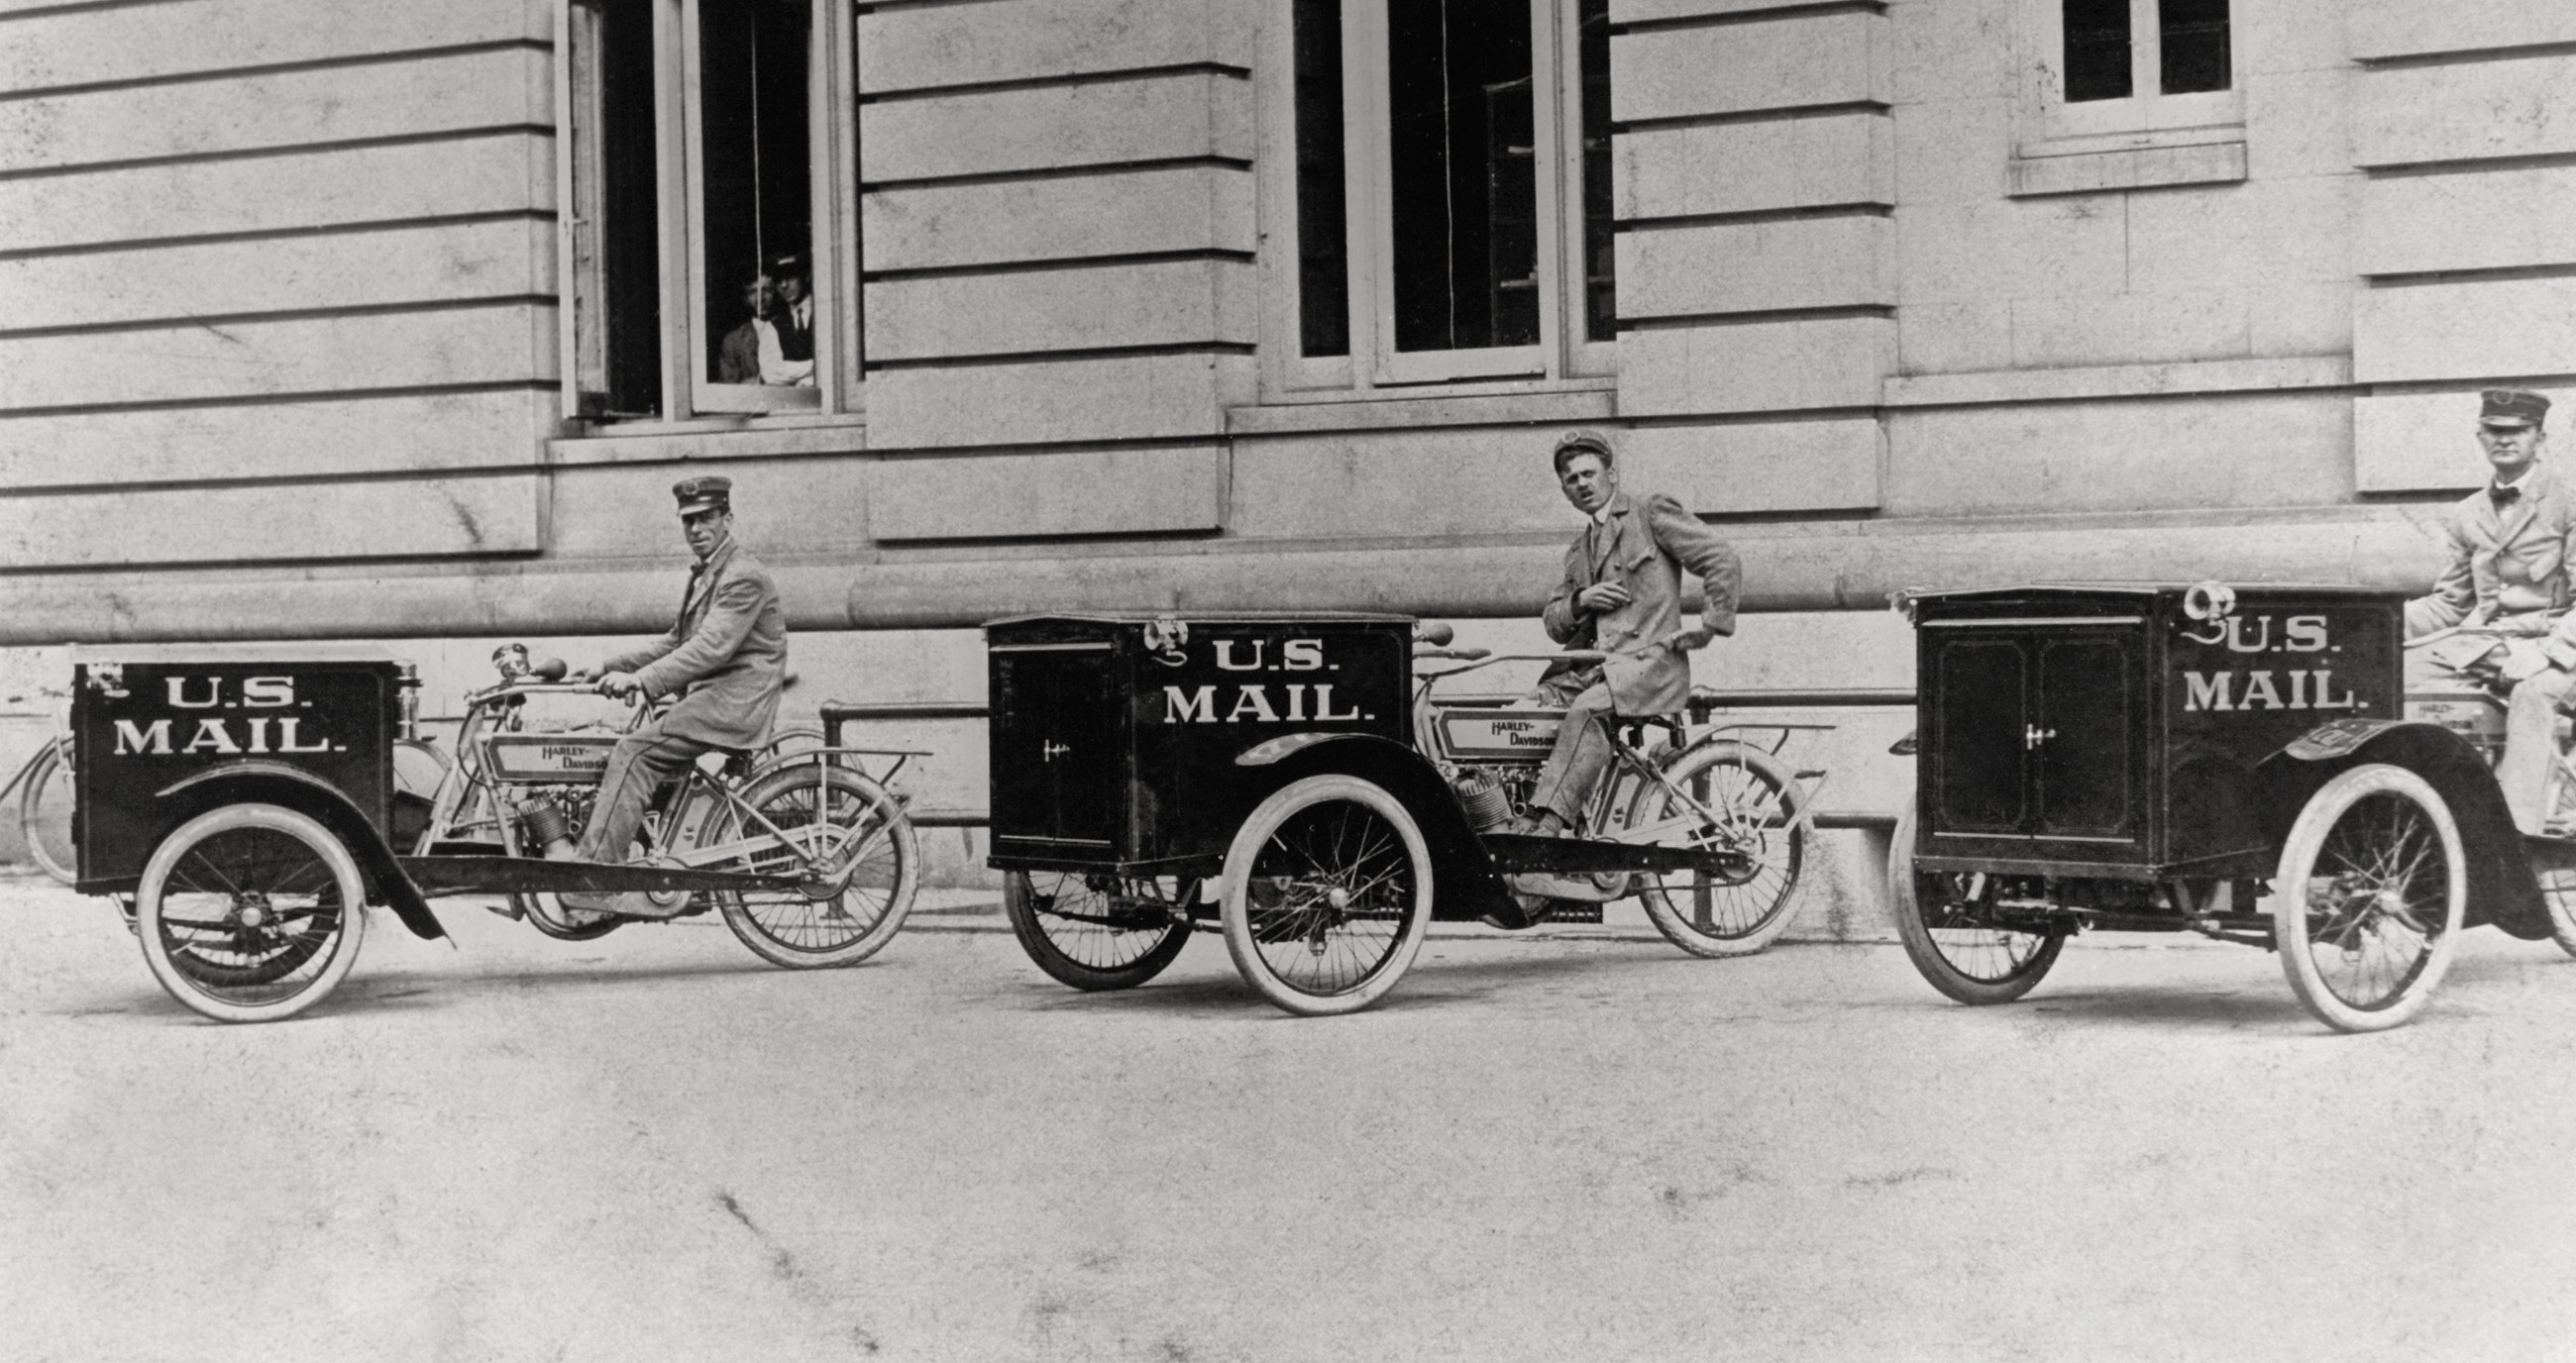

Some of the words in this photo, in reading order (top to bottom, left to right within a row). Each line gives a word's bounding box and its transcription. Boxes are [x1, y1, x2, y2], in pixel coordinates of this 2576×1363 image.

[2224, 615, 2342, 653] U.S.
[1212, 638, 1340, 672] U.S.
[164, 677, 313, 708] U.S.
[1163, 683, 1375, 724] MAIL.
[2183, 670, 2370, 712] MAIL.
[113, 716, 348, 756] MAIL.
[563, 756, 608, 770] DAVIDSO
